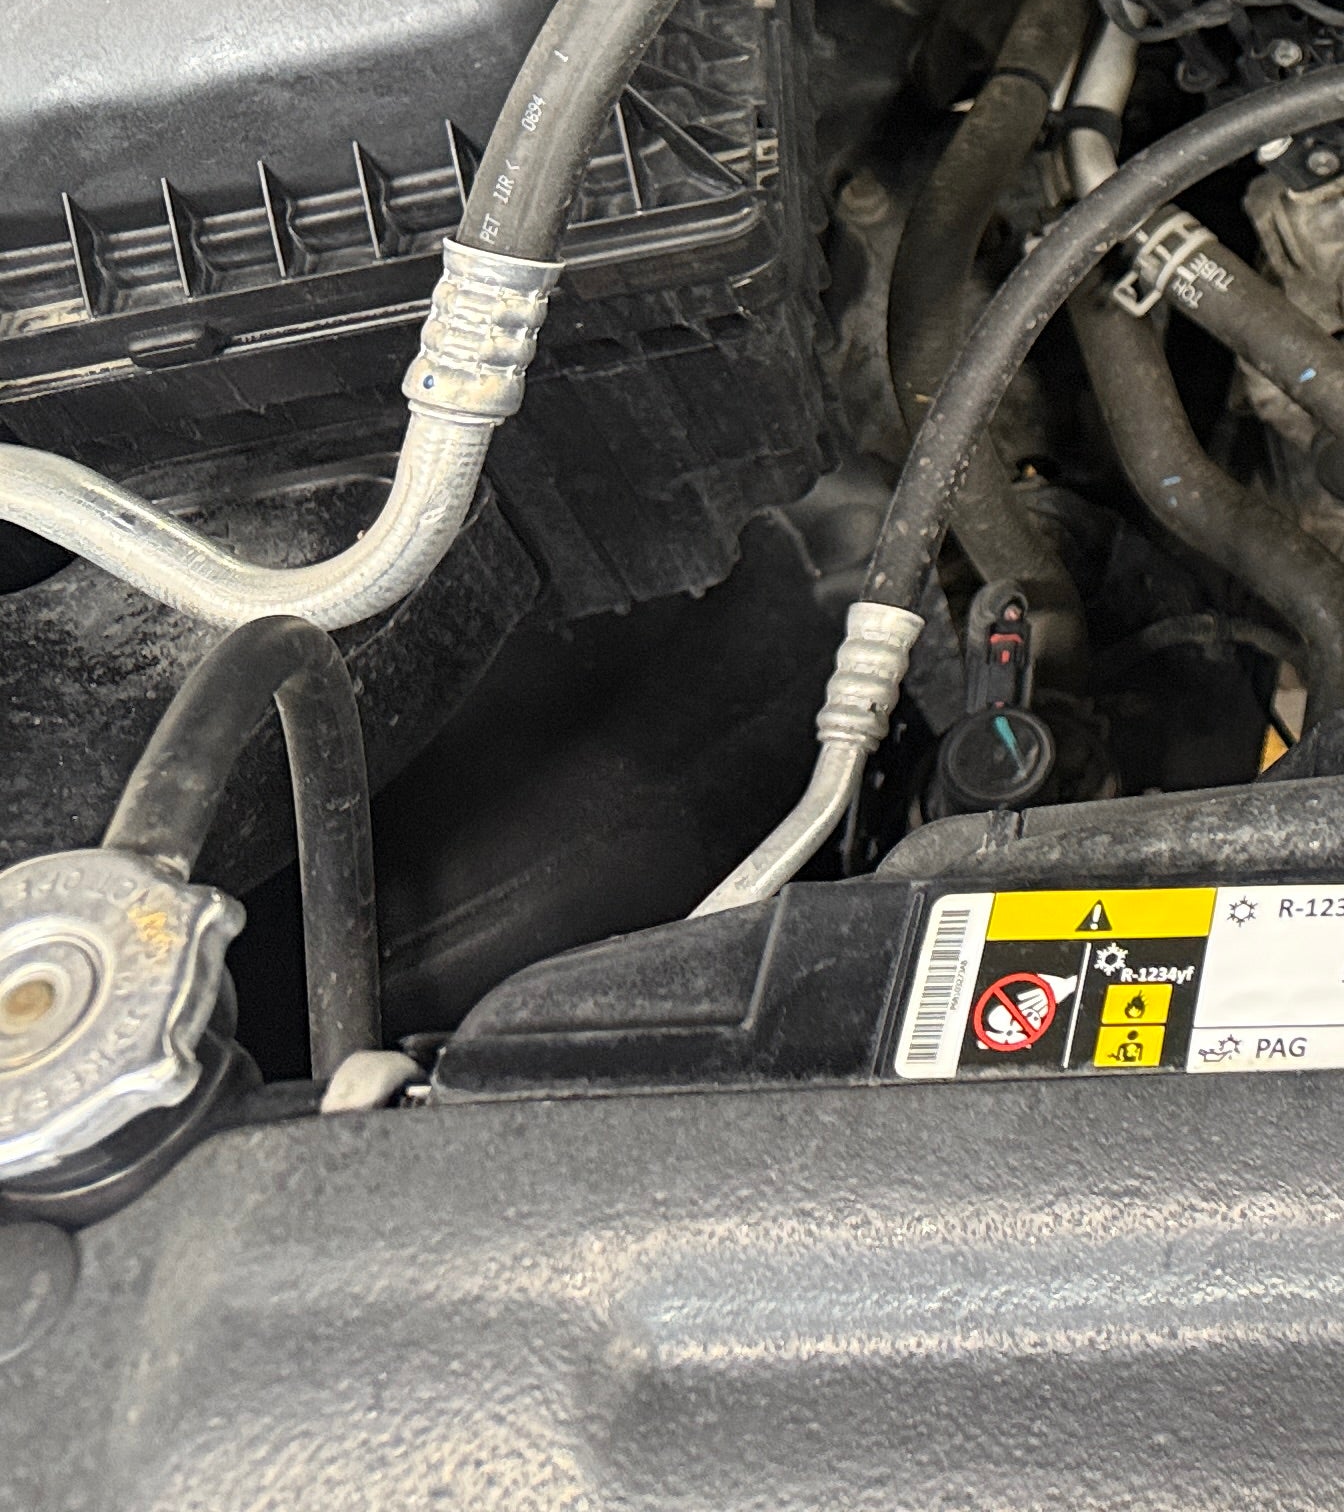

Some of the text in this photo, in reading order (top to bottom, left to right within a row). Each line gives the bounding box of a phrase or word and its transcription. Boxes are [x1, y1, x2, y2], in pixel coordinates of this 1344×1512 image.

[479, 212, 501, 245] PET
[521, 93, 547, 132] 0894
[1189, 252, 1235, 292] TUBE
[1120, 965, 1196, 985] R-1234yf
[1255, 1037, 1308, 1059] PAG
